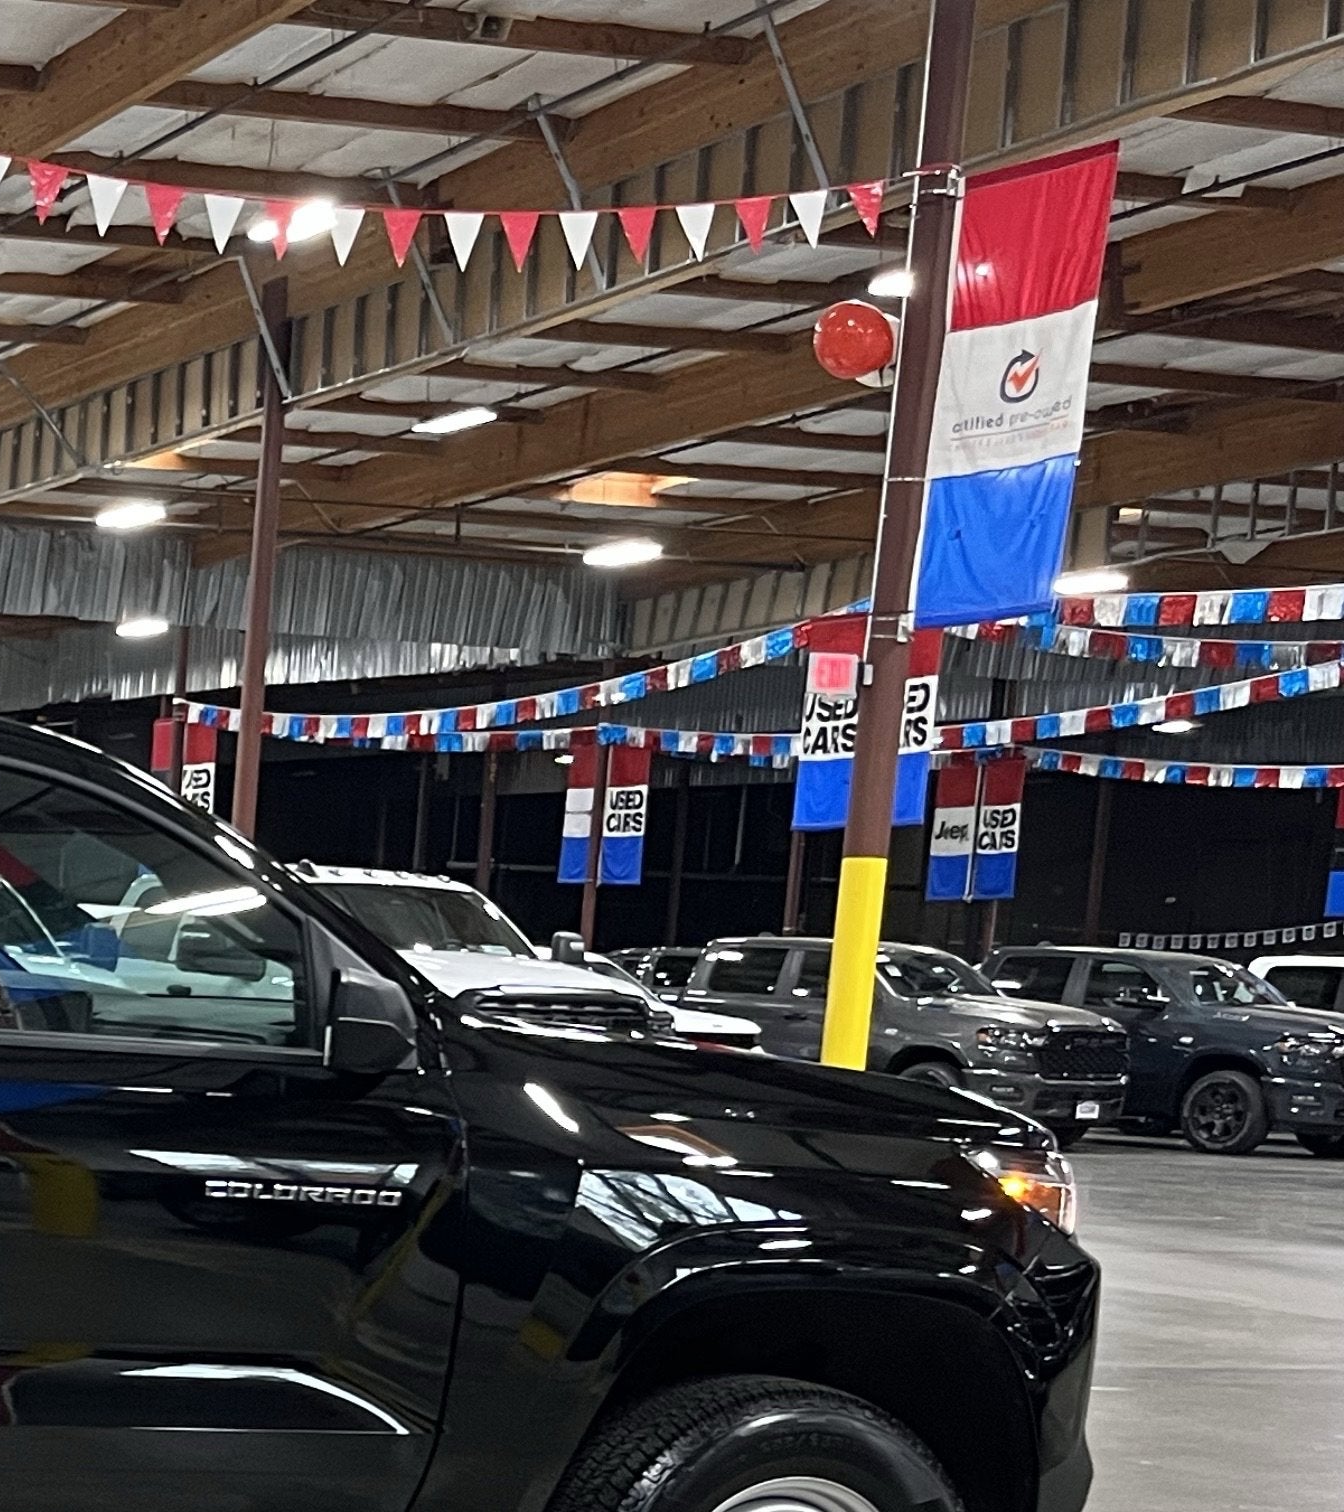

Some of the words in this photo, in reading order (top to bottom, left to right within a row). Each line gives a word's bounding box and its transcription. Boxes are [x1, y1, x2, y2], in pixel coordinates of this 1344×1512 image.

[952, 413, 1004, 434] ctified
[906, 683, 930, 713] ED
[803, 723, 857, 754] CARS
[903, 716, 928, 747] RS
[205, 1180, 402, 1206] COLORADO
